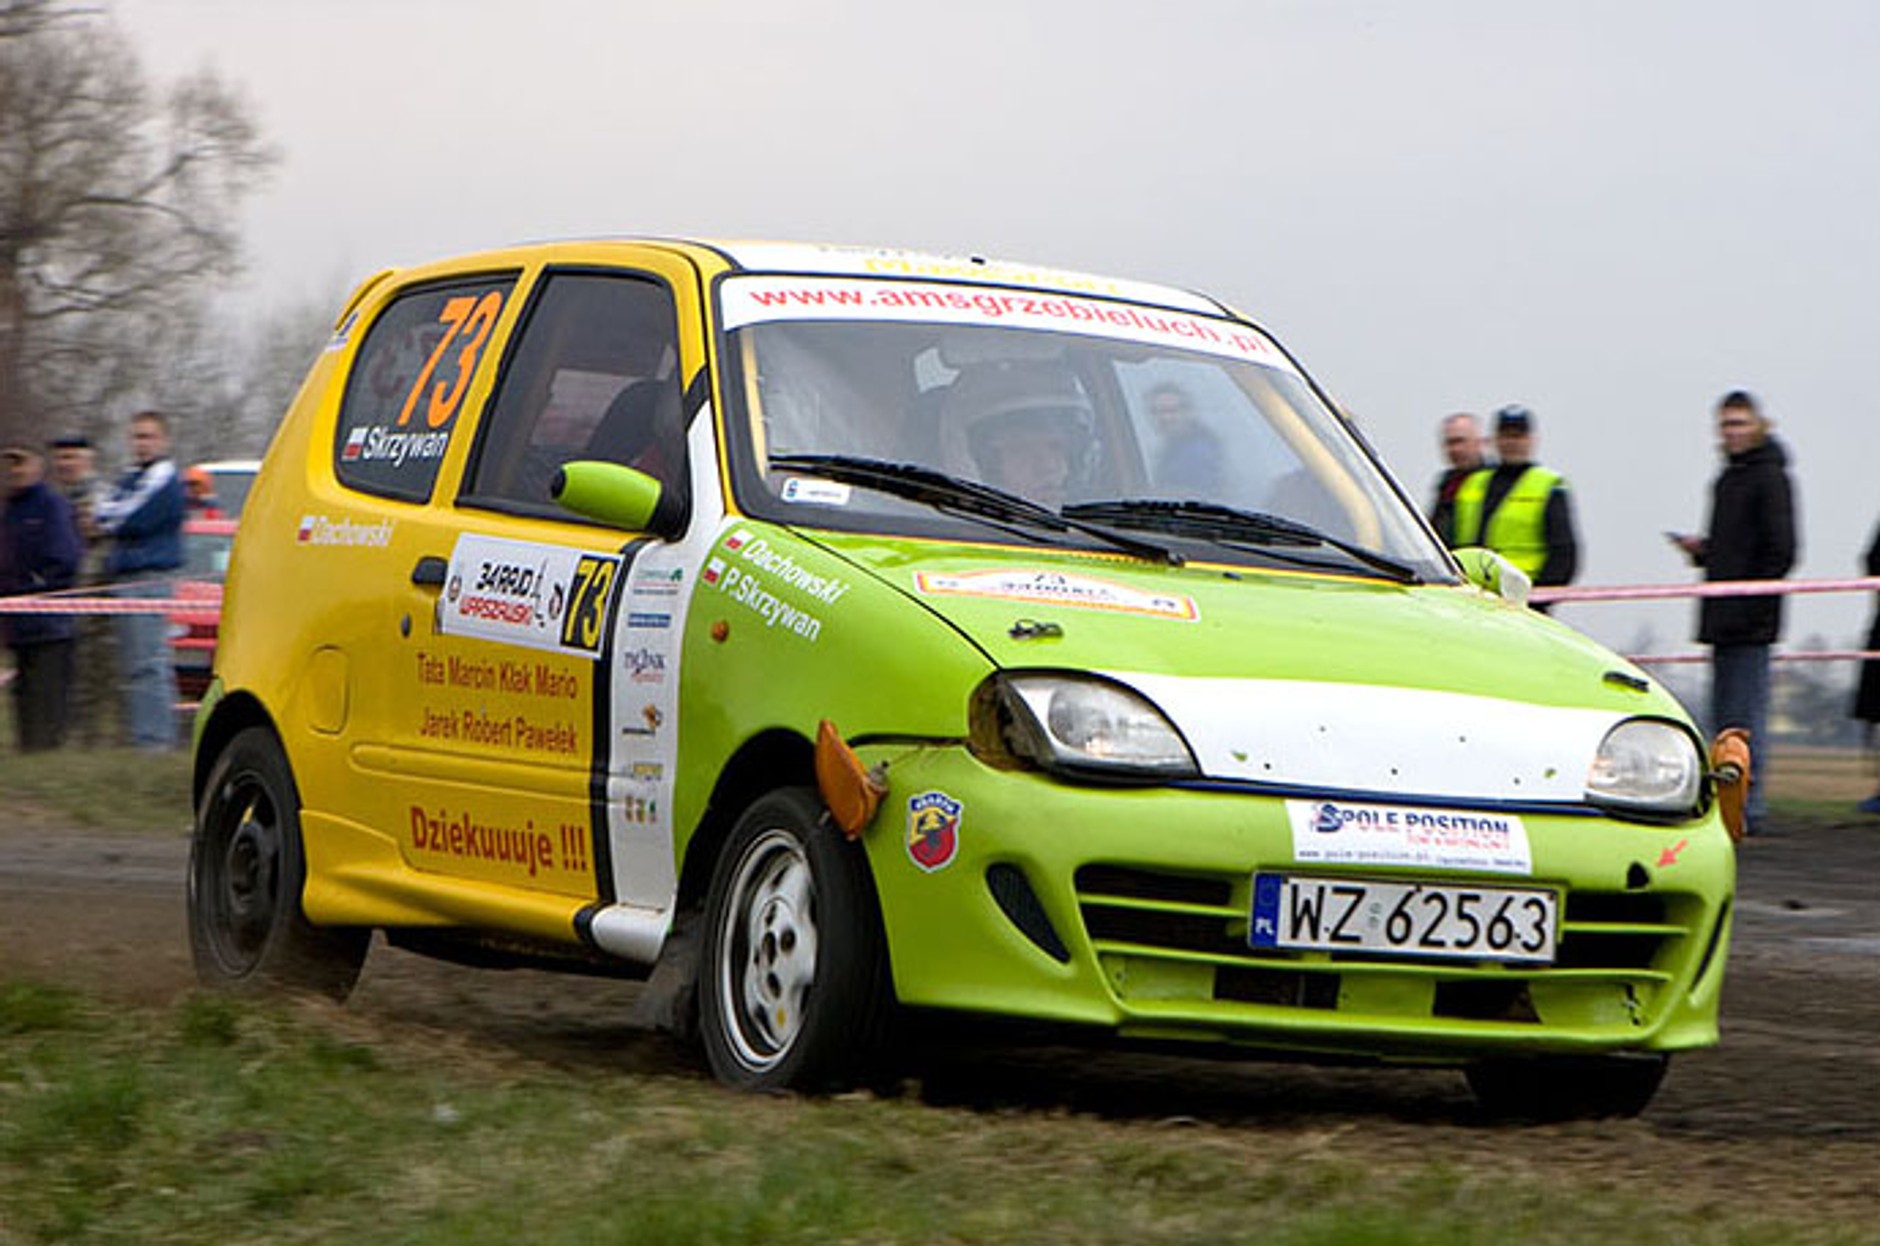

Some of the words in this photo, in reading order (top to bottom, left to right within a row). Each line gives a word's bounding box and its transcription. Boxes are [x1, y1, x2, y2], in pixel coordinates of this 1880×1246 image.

[749, 287, 1269, 354] www.amsgrzebieluch.pl
[397, 291, 503, 429] 73
[362, 426, 449, 467] Skrzywan
[564, 559, 615, 648] 73
[417, 652, 445, 684] Tata
[448, 655, 495, 689] Marcin
[535, 664, 577, 699] Mario
[420, 706, 459, 738] Jarek
[463, 709, 512, 746] Robert
[410, 805, 553, 877] Dziekuuuje
[560, 823, 588, 872] !!!
[1404, 812, 1509, 838] POSITION
[1289, 883, 1367, 943] WZ
[1385, 889, 1547, 952] 62563
